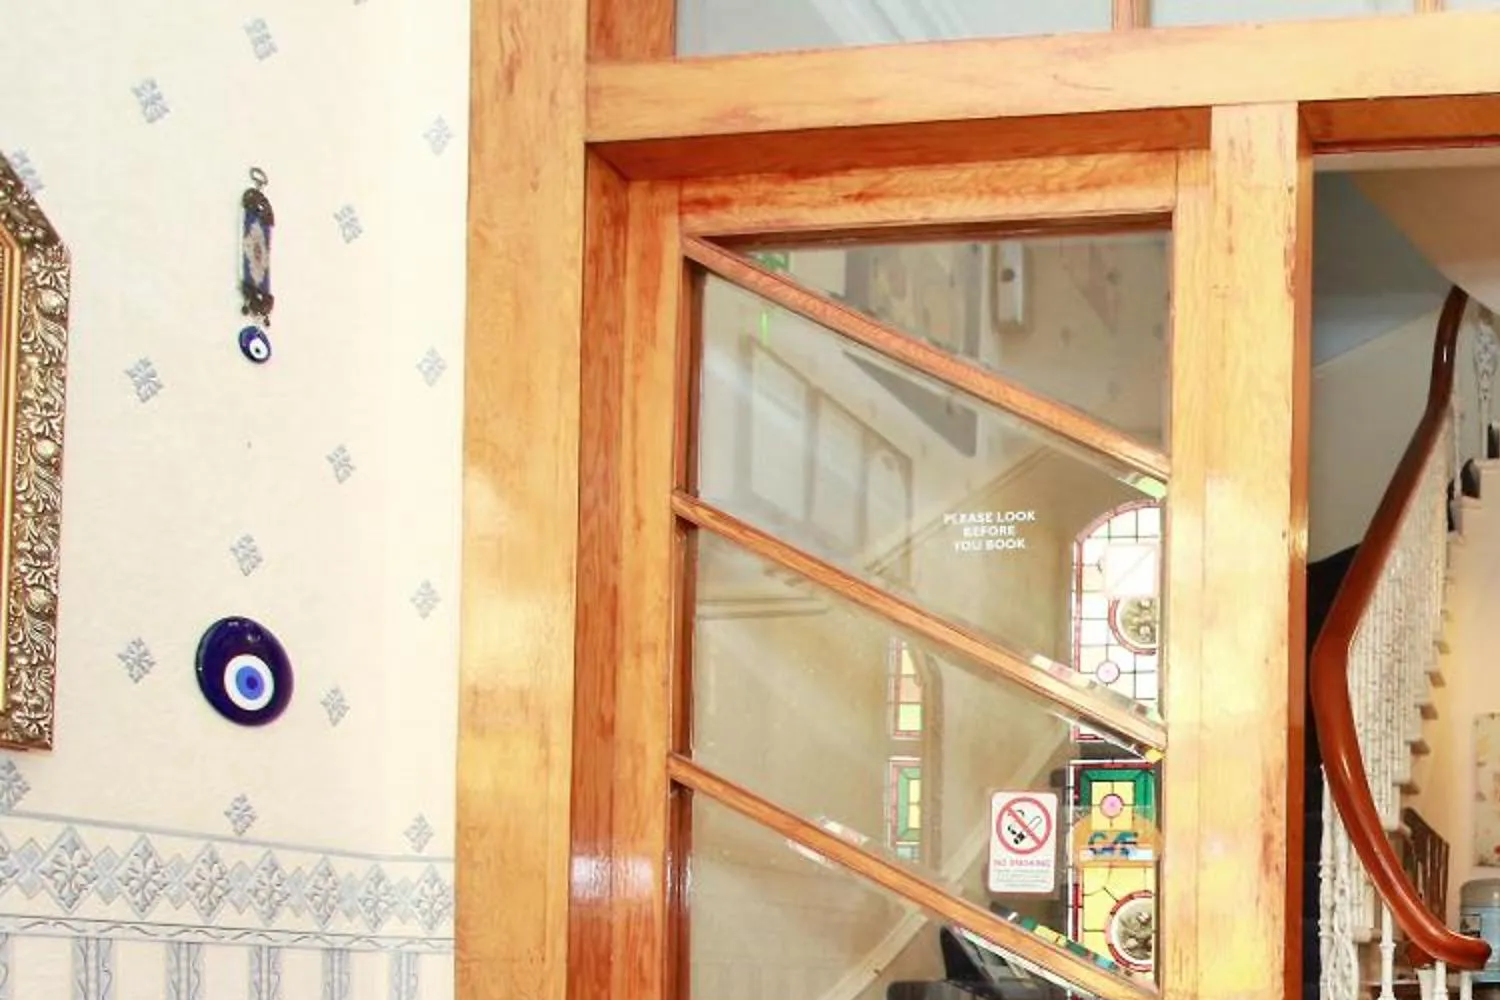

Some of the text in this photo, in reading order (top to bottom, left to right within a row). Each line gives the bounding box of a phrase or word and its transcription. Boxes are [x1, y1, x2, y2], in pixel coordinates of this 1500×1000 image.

[943, 510, 1036, 525] PLEASE LOOK
[963, 525, 1016, 537] BEFORE
[954, 538, 1026, 552] YOU BOOK
